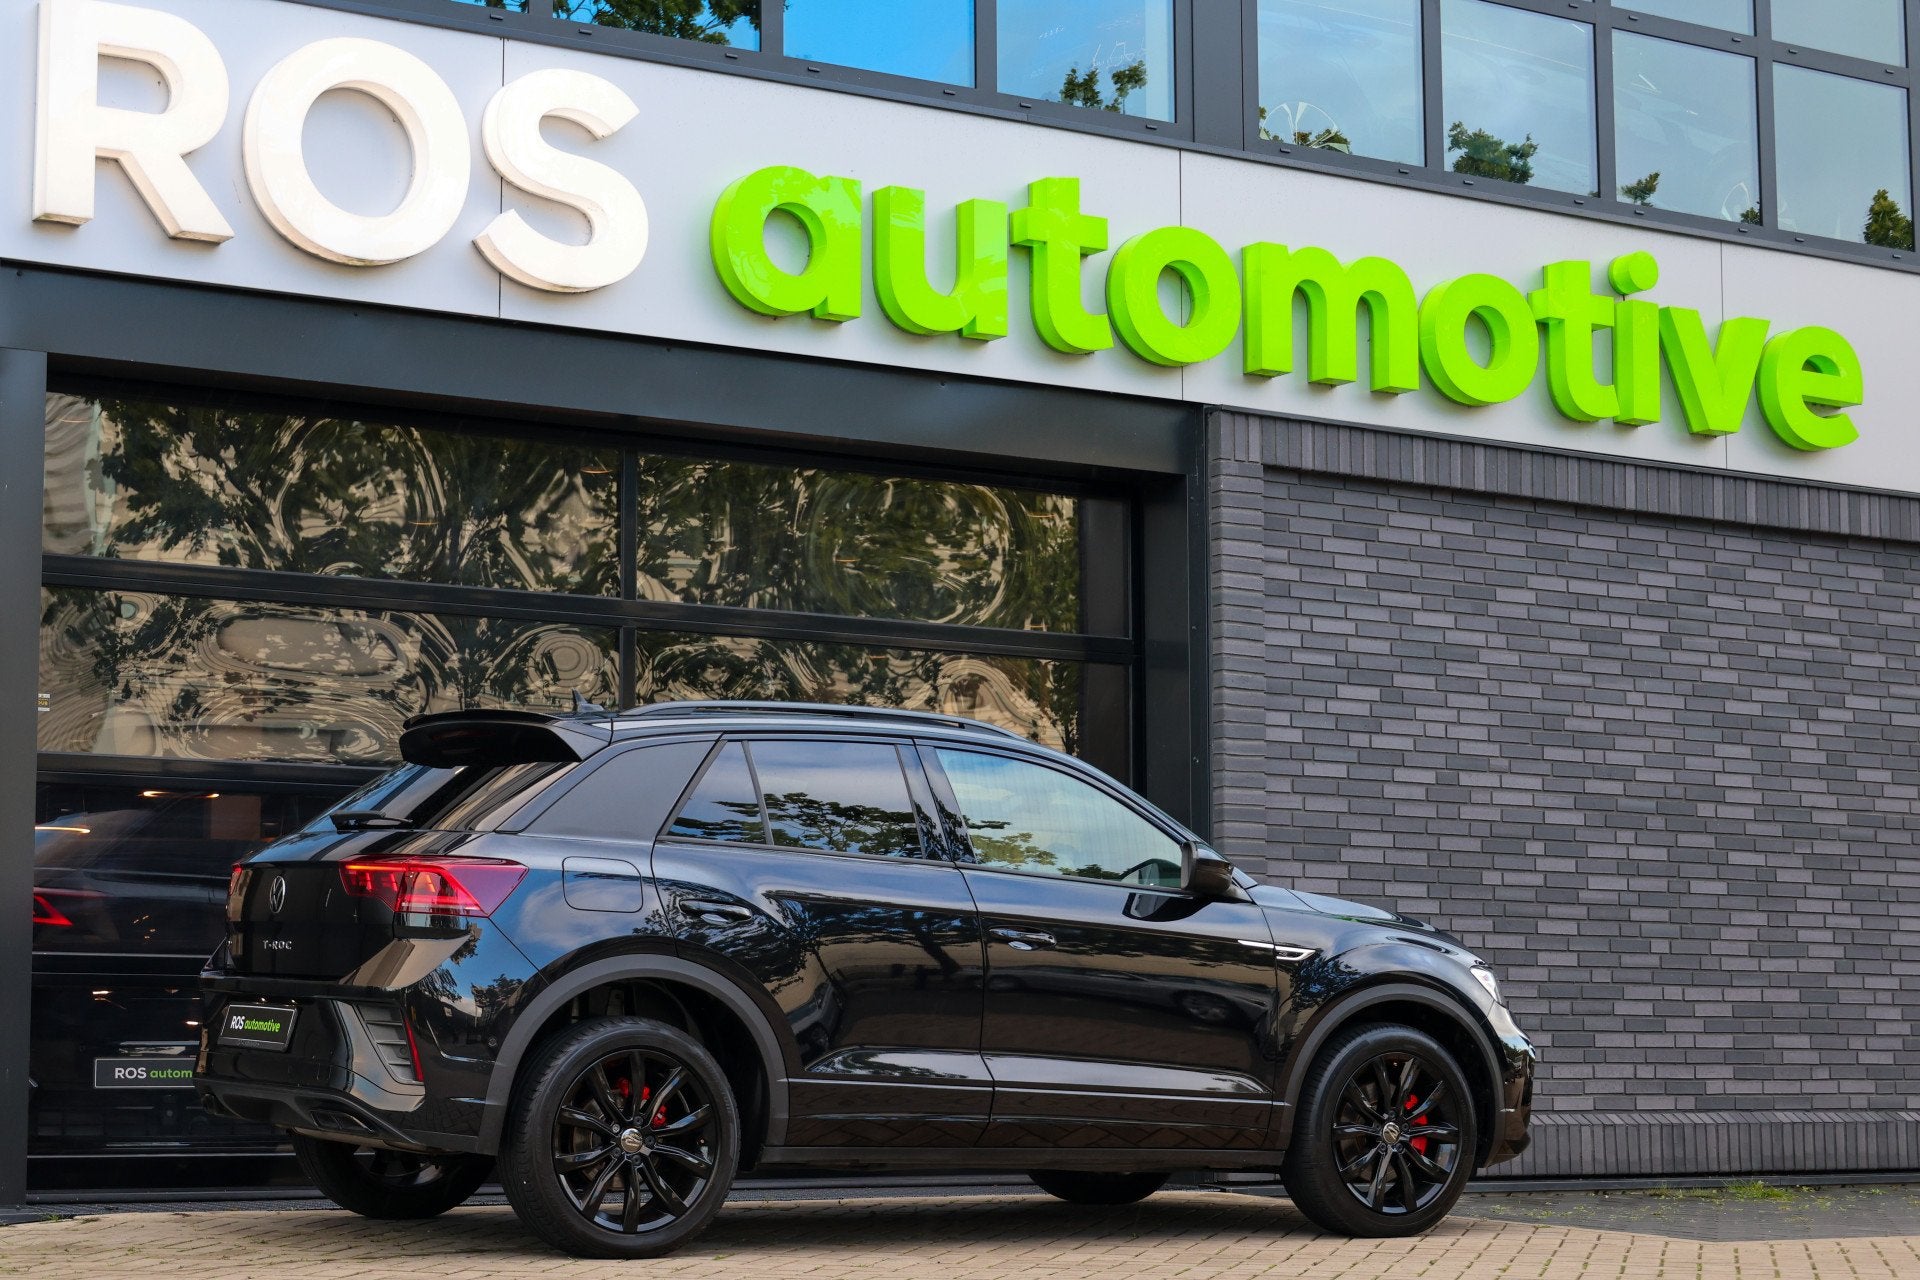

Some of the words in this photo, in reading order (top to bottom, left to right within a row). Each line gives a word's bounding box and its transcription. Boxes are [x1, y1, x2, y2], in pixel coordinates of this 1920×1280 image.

[32, 0, 649, 294] ROS
[709, 164, 1864, 452] automotive
[230, 1015, 246, 1030] ROS
[244, 1019, 281, 1032] automotive
[114, 1067, 147, 1079] ROS
[150, 1069, 193, 1078] autom
